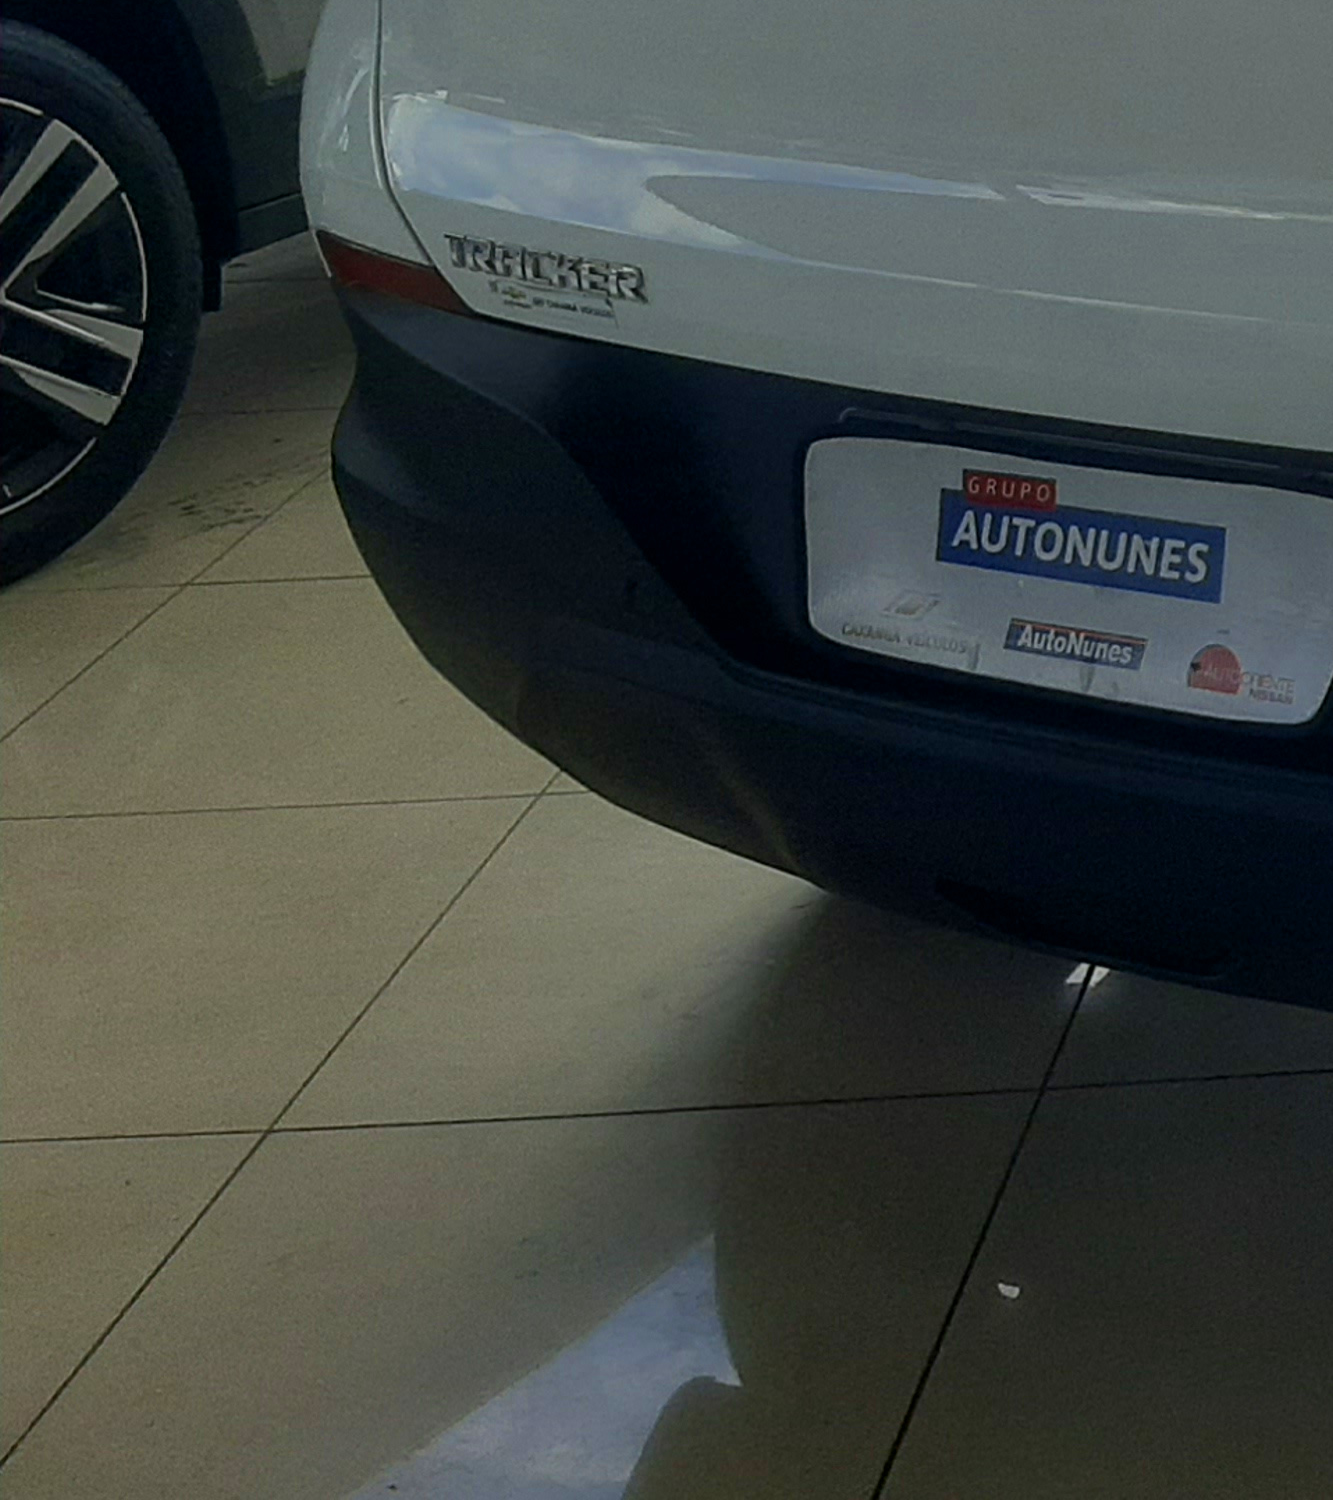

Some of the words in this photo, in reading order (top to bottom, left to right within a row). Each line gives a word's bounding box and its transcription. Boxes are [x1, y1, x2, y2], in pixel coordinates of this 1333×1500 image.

[444, 234, 648, 304] TRACKER
[968, 475, 1051, 503] GRUPO
[952, 509, 1211, 584] AUTONUNES
[1017, 623, 1134, 664] AutoNunes
